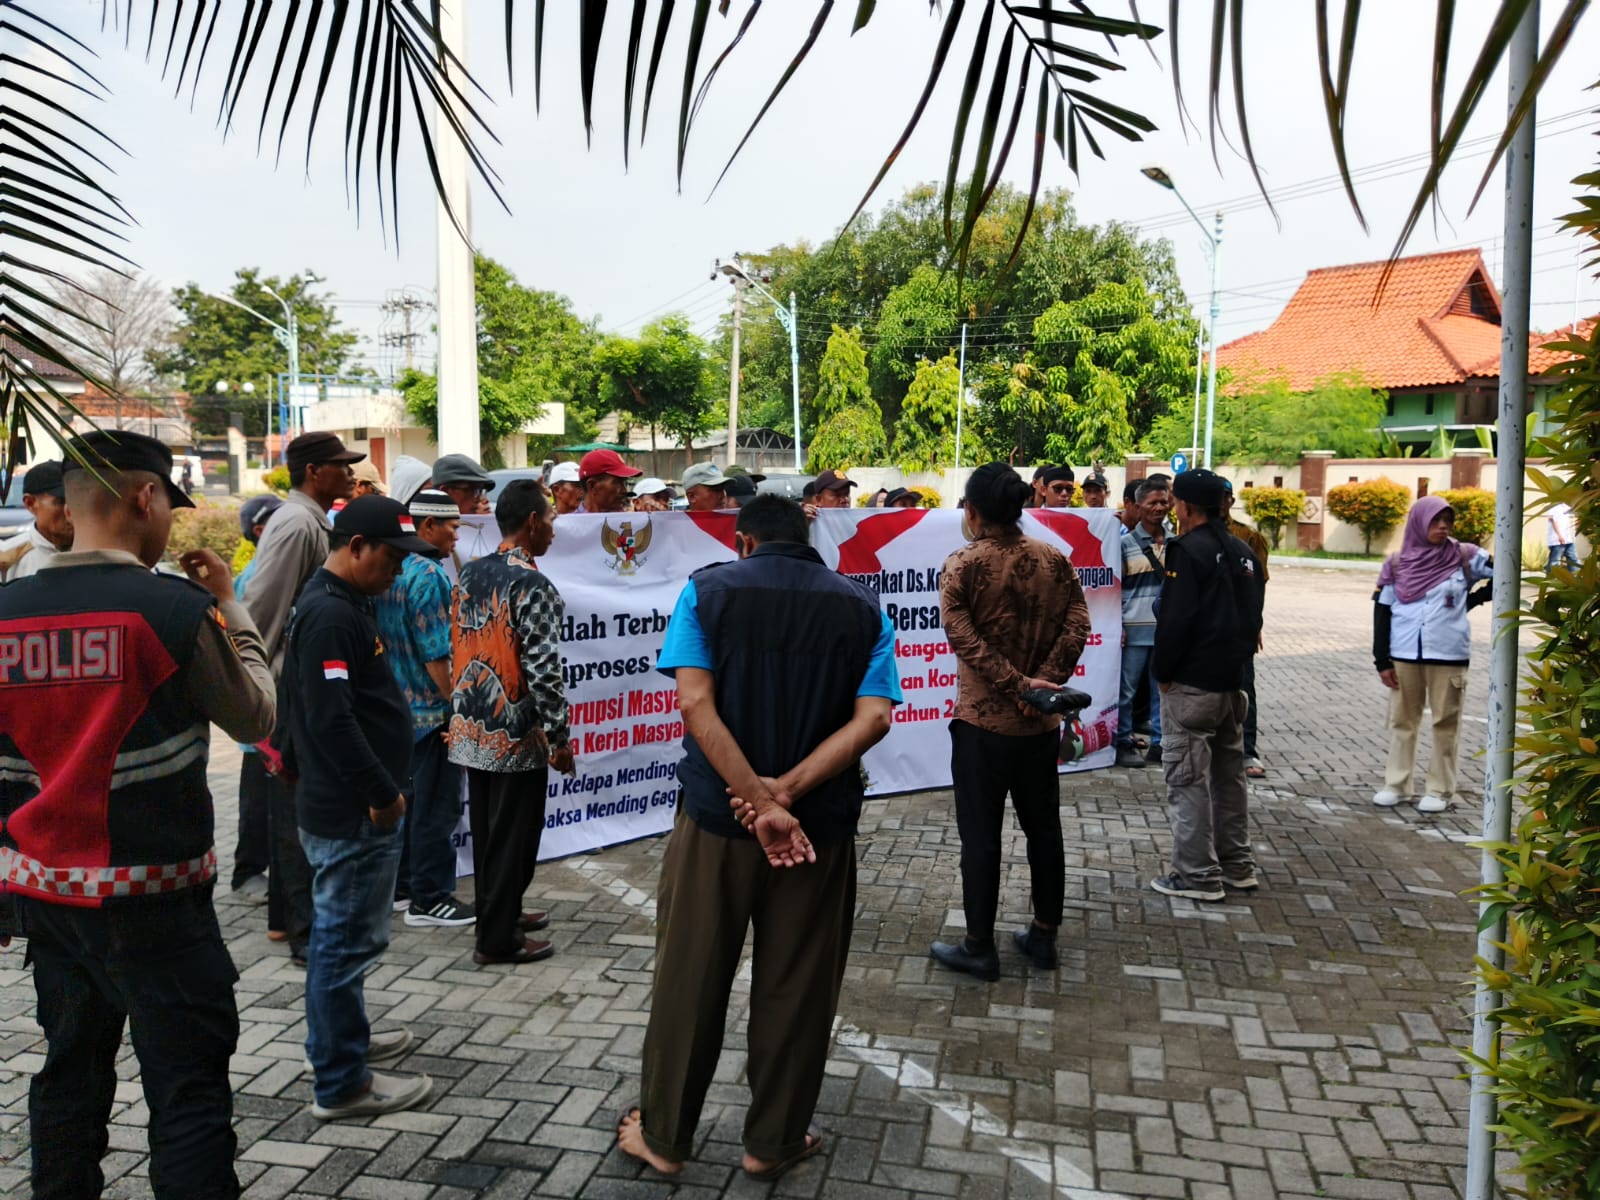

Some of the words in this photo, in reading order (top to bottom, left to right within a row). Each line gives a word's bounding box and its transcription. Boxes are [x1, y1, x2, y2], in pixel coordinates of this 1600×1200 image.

[1076, 567, 1114, 588] angan
[887, 603, 944, 631] Bersa
[584, 728, 629, 754] Kerja
[562, 773, 613, 795] Kelapa
[616, 760, 677, 786] Mending
[586, 795, 649, 821] Mending
[651, 784, 680, 808] Gag
